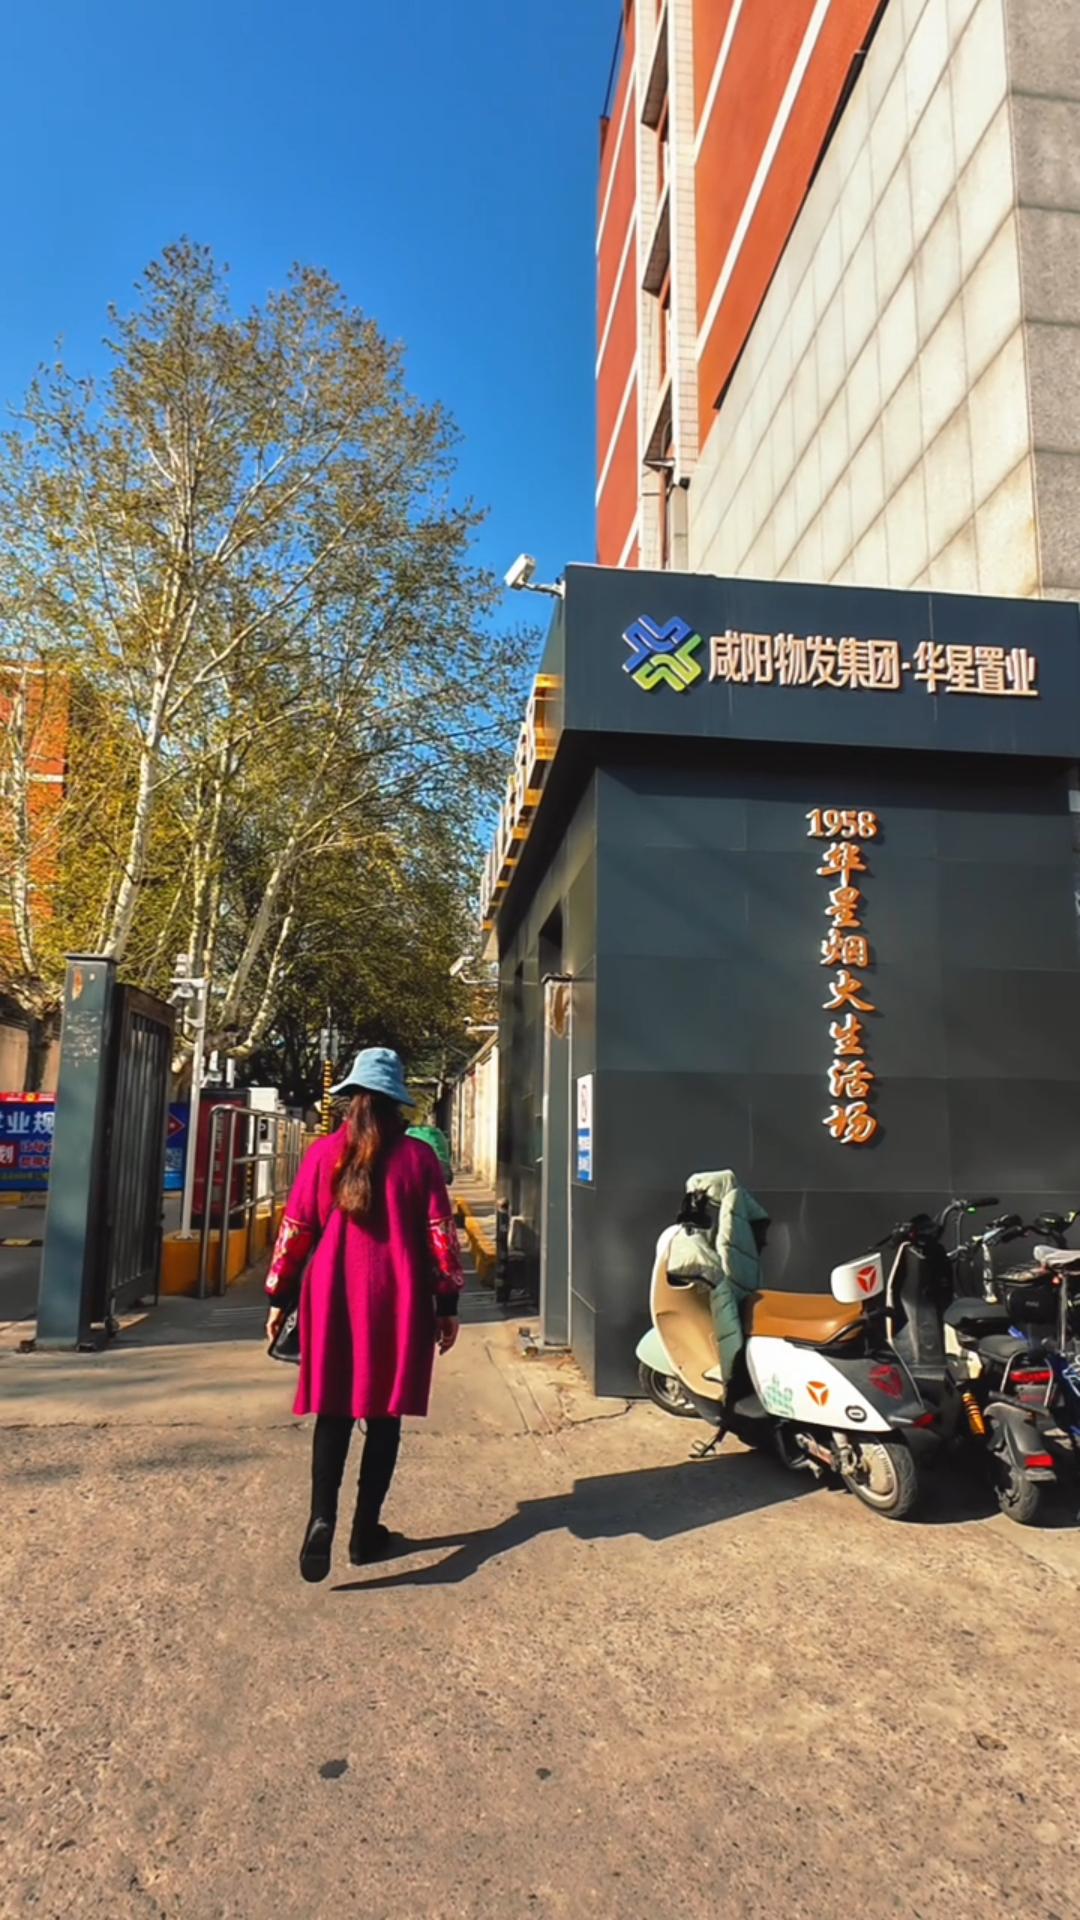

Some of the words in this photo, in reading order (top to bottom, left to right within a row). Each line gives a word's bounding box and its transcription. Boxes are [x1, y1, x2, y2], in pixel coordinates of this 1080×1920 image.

[708, 630, 1039, 697] 咸阳物发集团·华星置业
[805, 808, 878, 838] 1958
[817, 842, 878, 1144] 华星烟火生活场
